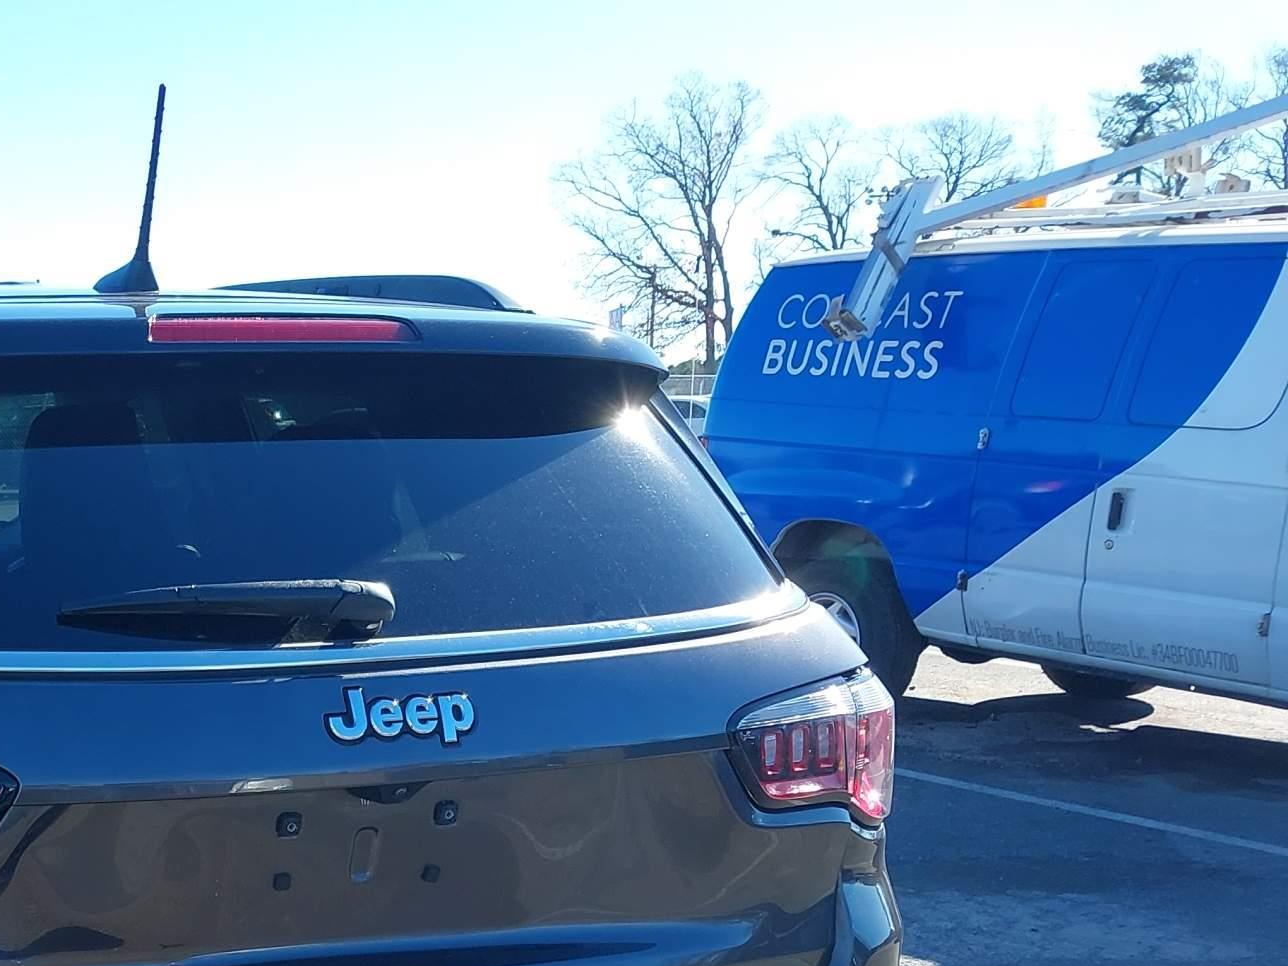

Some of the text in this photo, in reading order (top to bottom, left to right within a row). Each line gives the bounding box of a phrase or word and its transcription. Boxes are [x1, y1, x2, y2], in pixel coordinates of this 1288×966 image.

[777, 291, 964, 329] COAST
[762, 339, 944, 379] BUSINESS
[325, 686, 476, 745] Jeep
